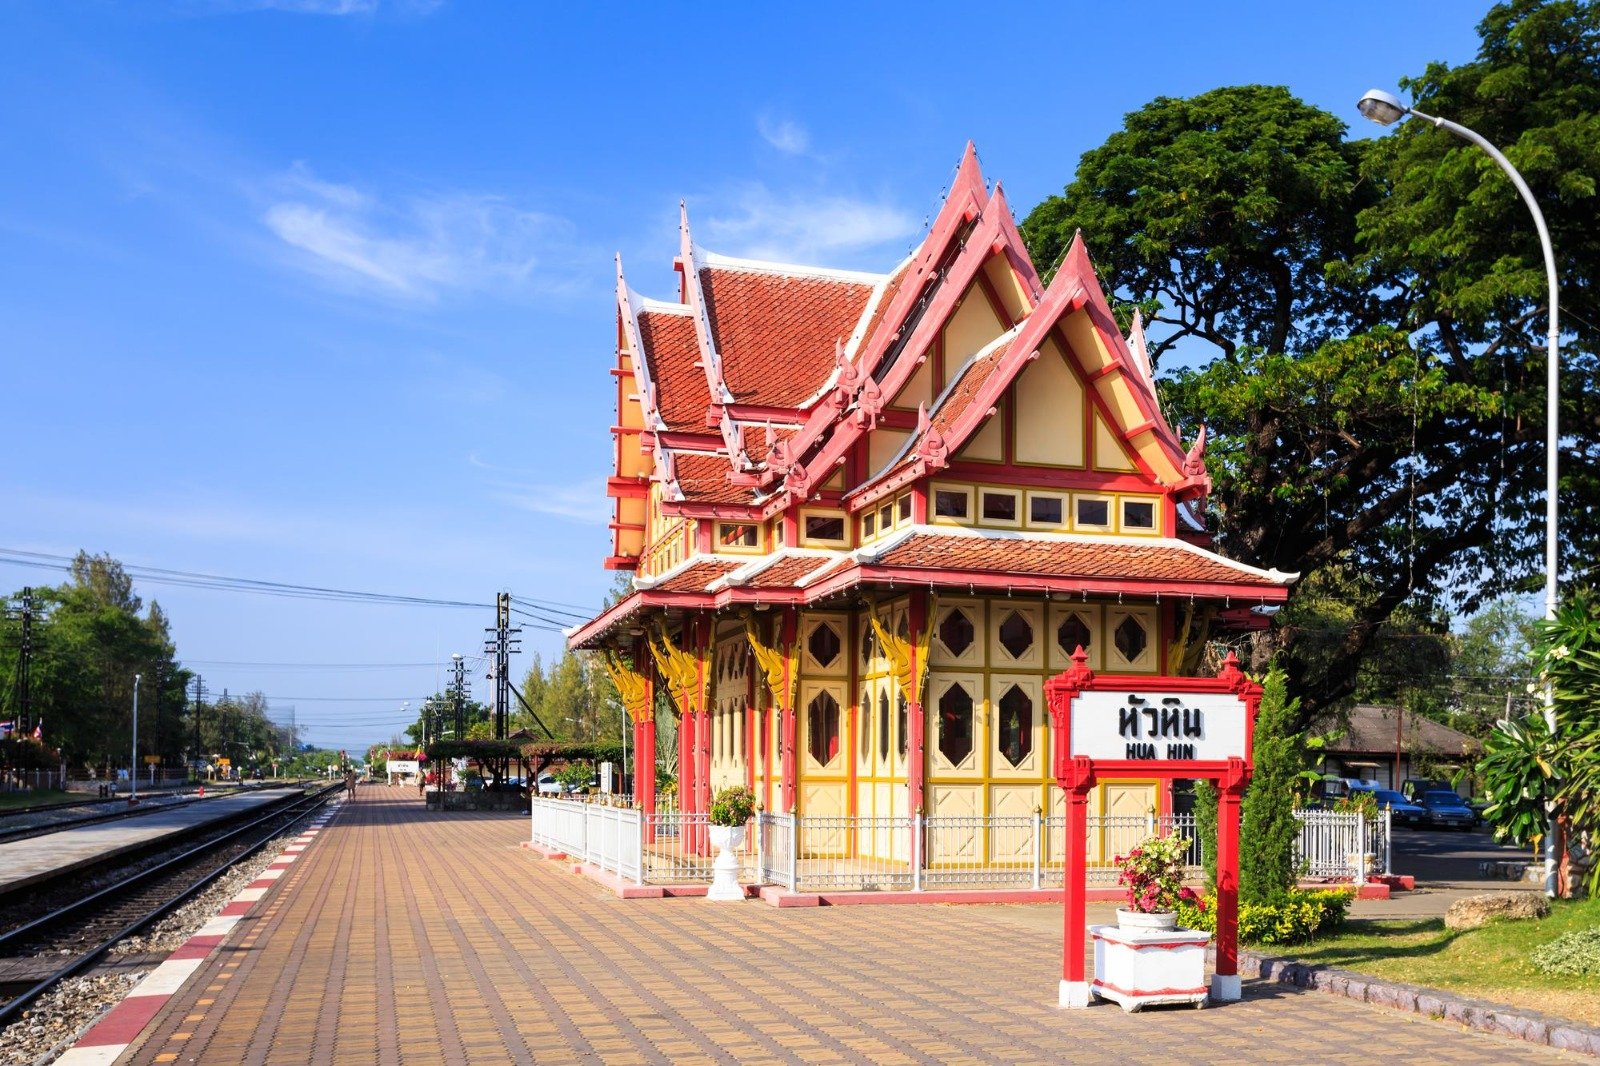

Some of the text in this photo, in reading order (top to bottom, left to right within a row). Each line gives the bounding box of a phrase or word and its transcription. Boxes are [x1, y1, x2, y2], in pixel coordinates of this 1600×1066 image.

[1119, 694, 1202, 738] หัวหิน
[1126, 743, 1194, 760] HUA HIN
